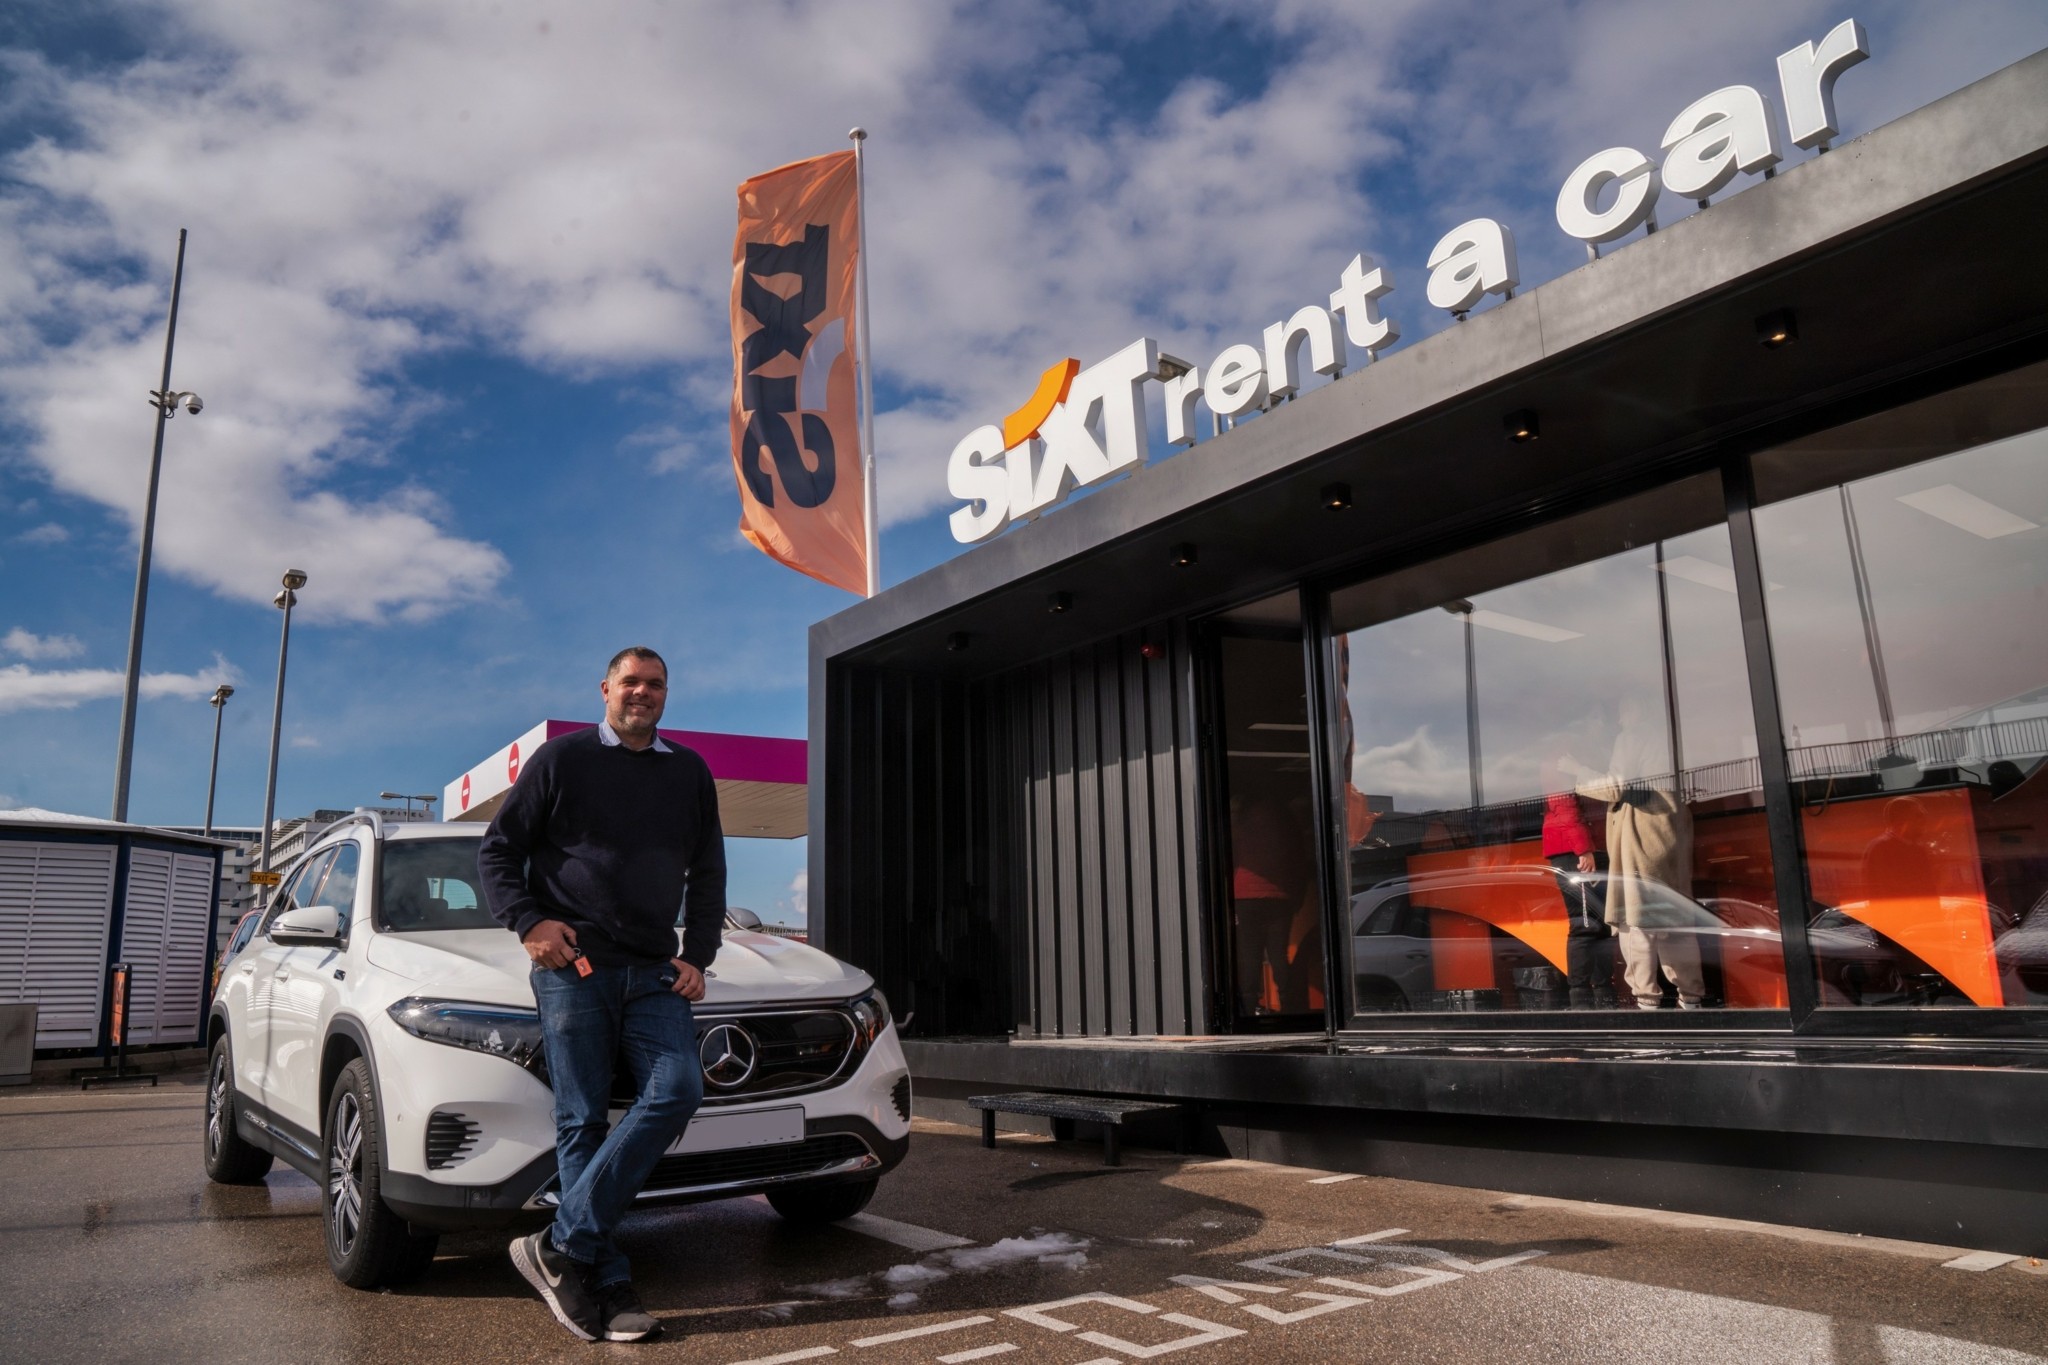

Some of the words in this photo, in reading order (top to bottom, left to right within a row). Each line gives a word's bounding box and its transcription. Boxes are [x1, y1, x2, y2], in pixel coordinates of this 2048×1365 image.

[1164, 253, 1400, 446] rent
[1427, 218, 1520, 312] a
[1556, 18, 1870, 244] car
[373, 808, 424, 818] OFITEL
[251, 874, 270, 882] EXIT
[728, 1228, 1549, 1365] ΞΟΔΟΣ
